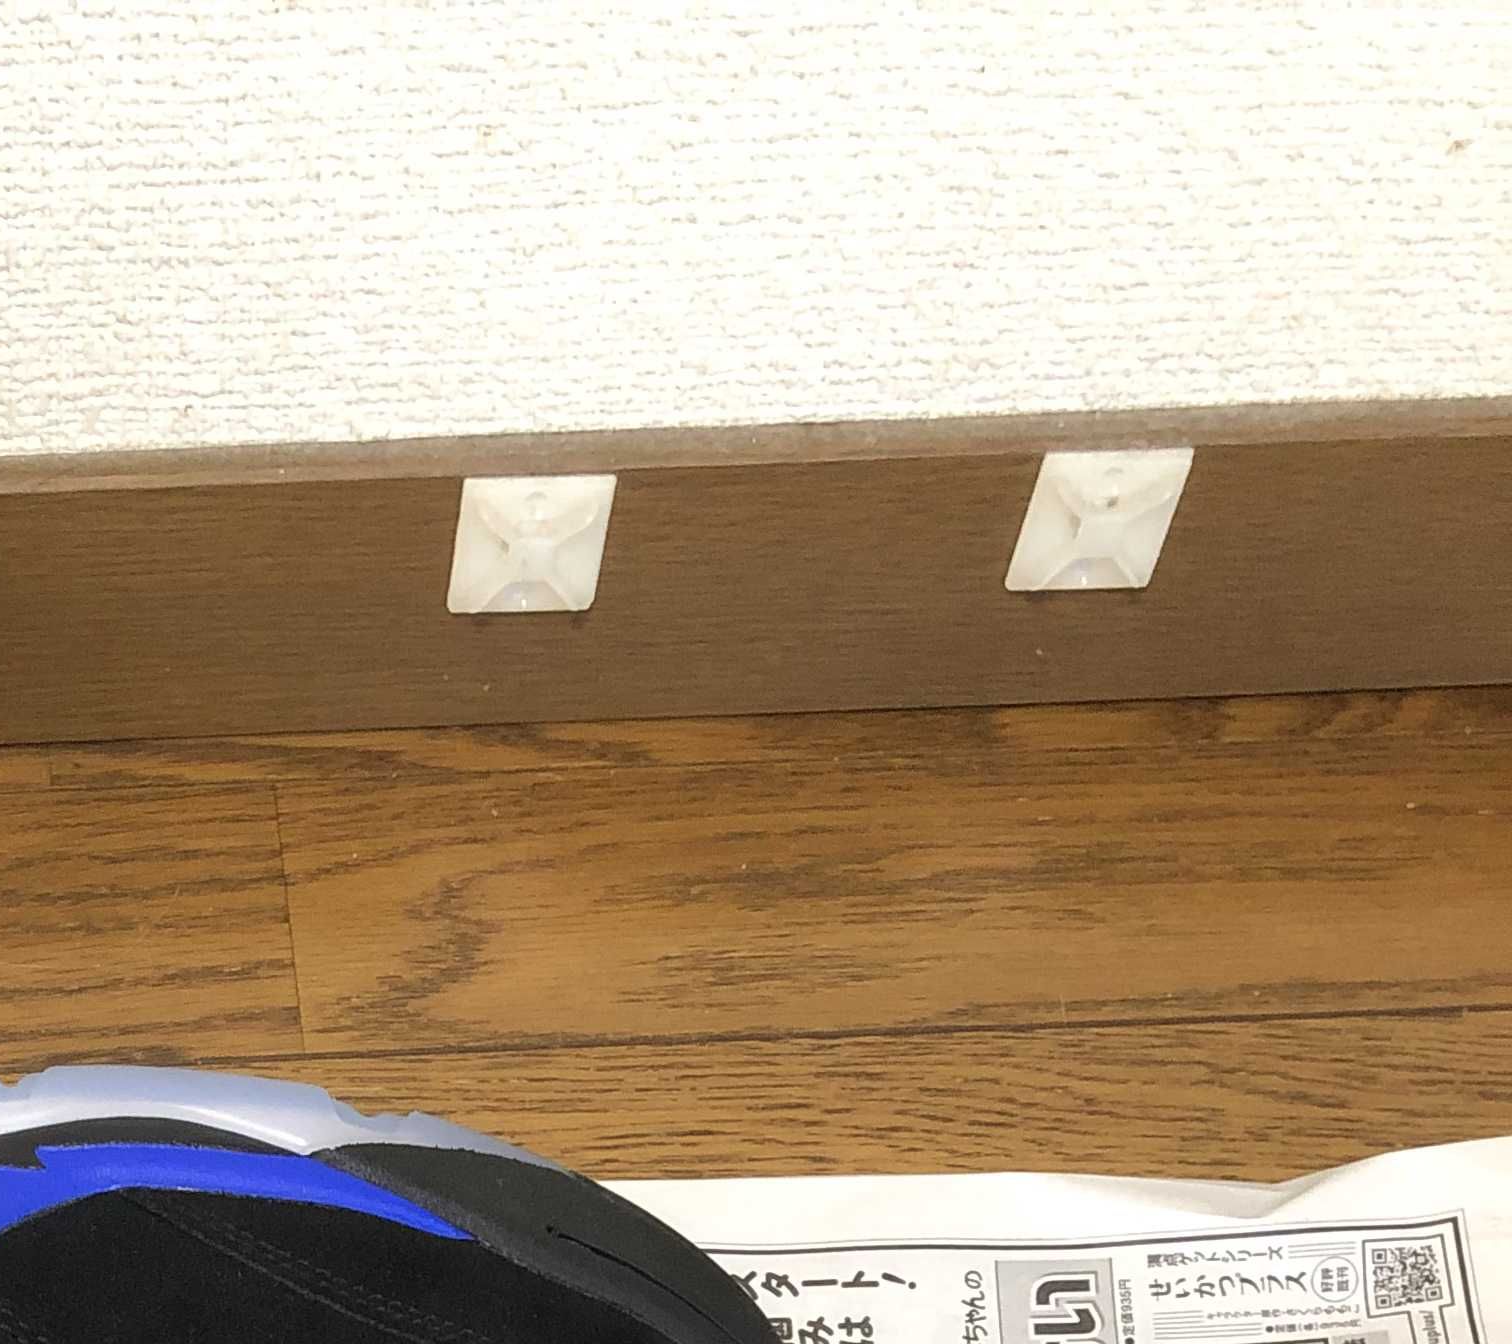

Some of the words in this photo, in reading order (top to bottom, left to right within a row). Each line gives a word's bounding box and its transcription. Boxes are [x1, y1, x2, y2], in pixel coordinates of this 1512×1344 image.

[1147, 1246, 1283, 1268] 満点ゲットシリーズ
[1149, 1272, 1308, 1301] せいかつプラス
